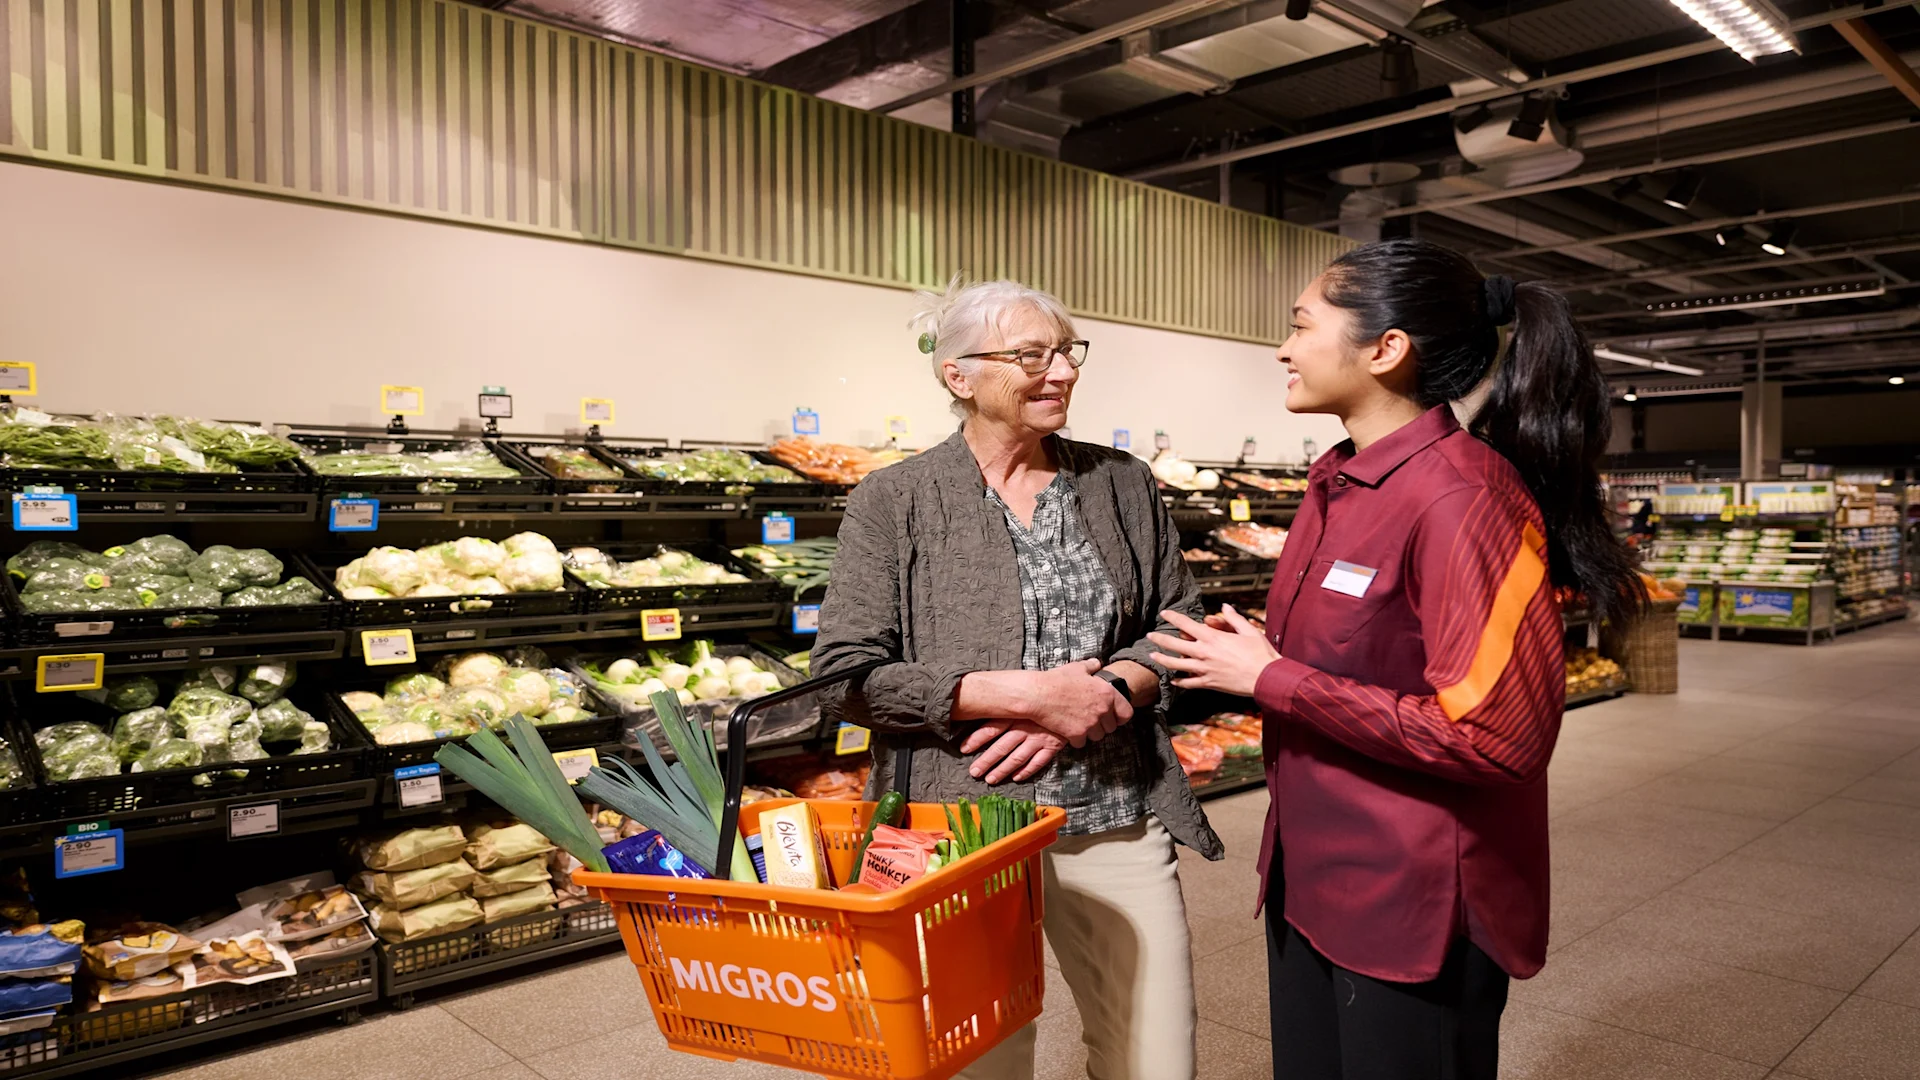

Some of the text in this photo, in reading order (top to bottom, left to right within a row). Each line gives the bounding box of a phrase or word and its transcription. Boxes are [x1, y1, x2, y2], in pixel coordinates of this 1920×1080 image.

[232, 808, 256, 817] 2.90
[78, 822, 99, 832] BIO
[64, 841, 92, 851] 2.90
[867, 858, 912, 885] MONKEY
[669, 957, 837, 1012] MIGROS
